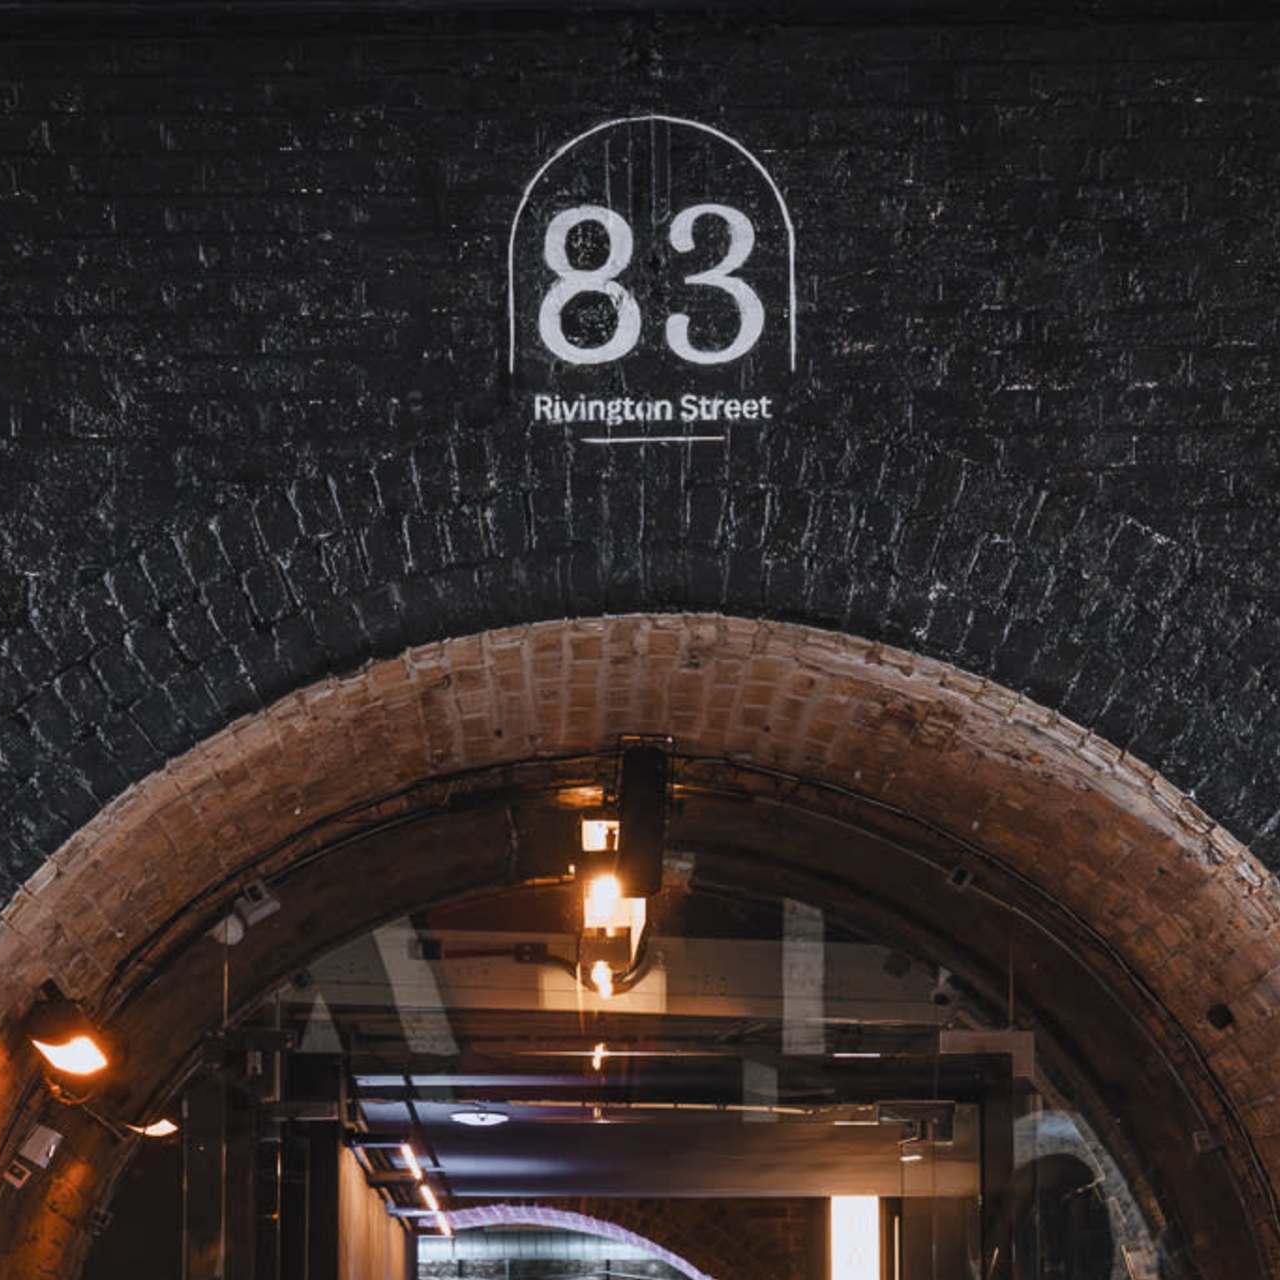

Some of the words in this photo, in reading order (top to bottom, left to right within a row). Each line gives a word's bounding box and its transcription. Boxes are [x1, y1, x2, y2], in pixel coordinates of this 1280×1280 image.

[538, 203, 766, 365] 83
[534, 394, 673, 424] Rivington
[679, 394, 773, 420] Street
